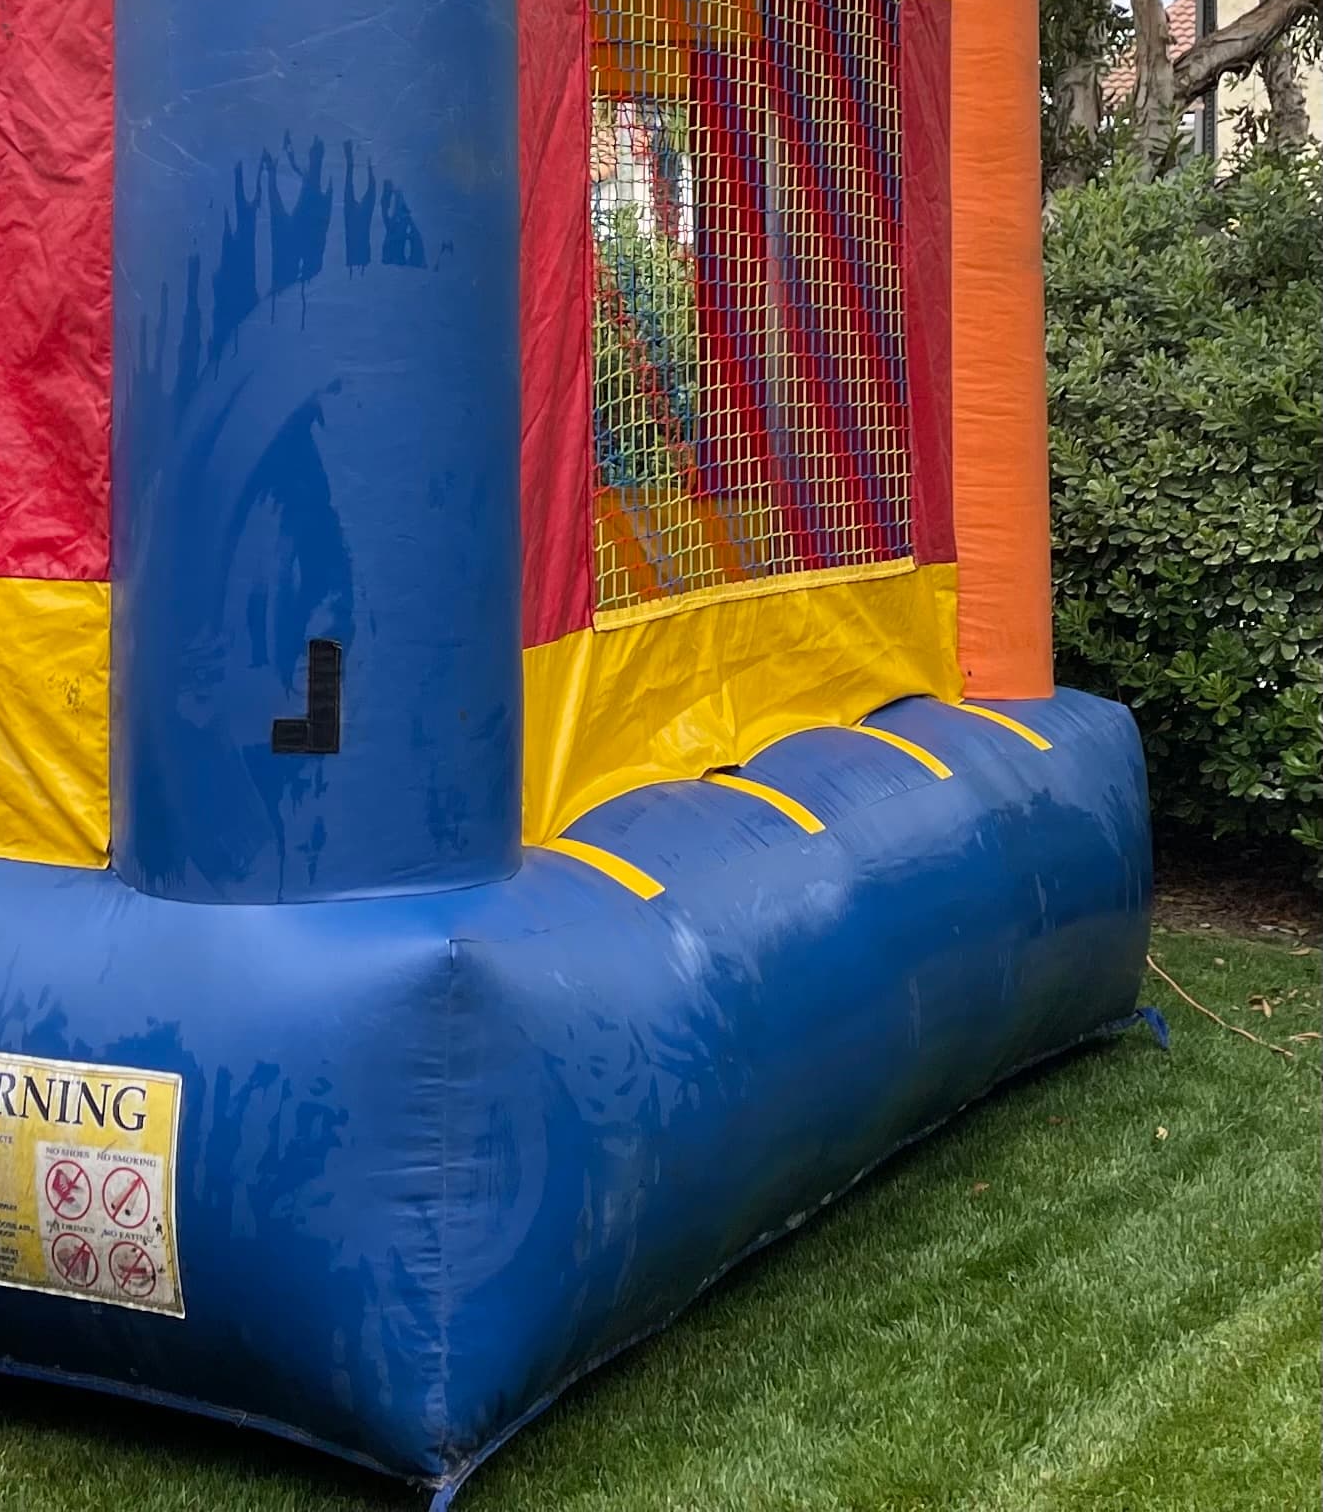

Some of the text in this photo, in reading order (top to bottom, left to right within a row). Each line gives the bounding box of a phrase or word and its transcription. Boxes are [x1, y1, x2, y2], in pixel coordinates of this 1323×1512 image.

[46, 1146, 90, 1159] NO SHOES
[96, 1152, 157, 1168] NO SMOKING
[102, 1228, 155, 1244] NO EATING
